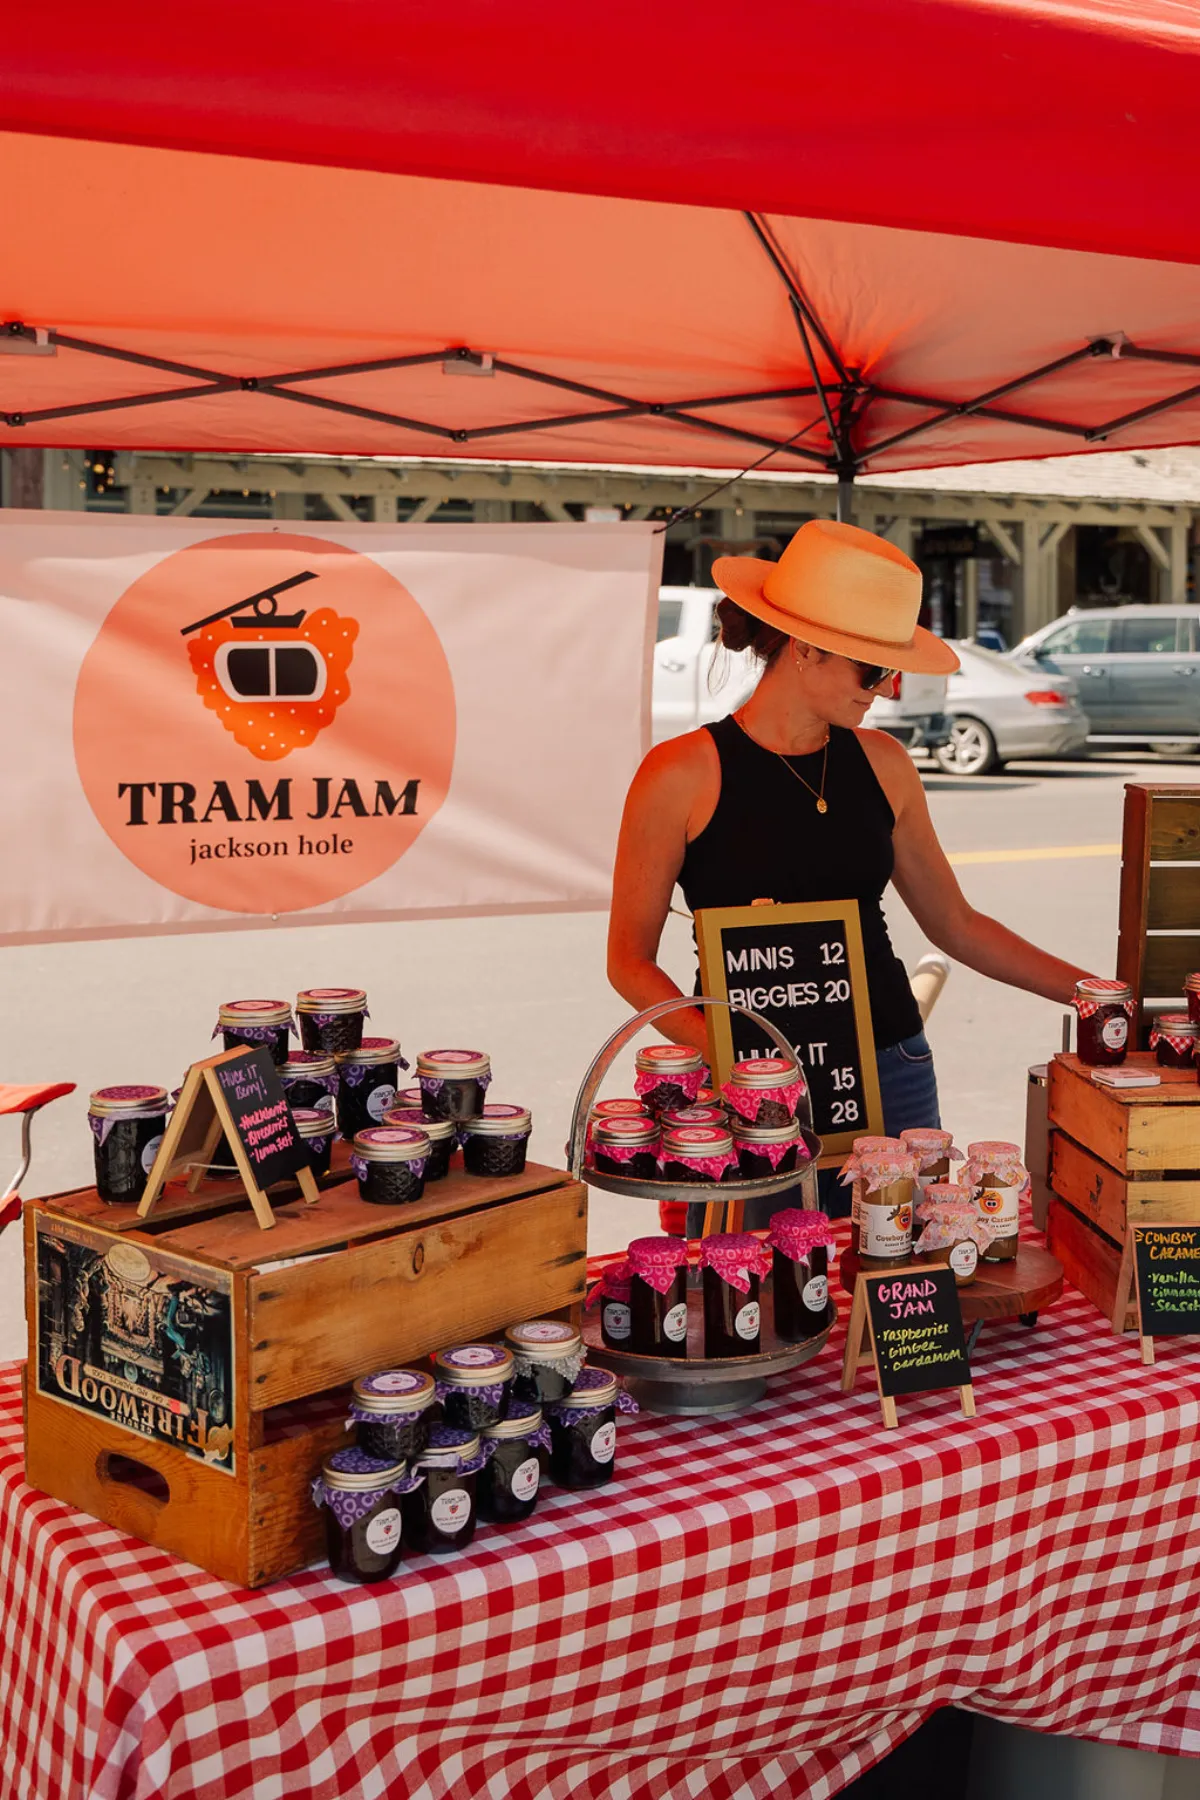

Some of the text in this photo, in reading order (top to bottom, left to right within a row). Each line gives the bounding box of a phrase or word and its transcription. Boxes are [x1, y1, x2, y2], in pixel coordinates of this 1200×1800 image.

[118, 777, 422, 826] TRAM JAM
[190, 834, 353, 865] jackson hole
[726, 942, 846, 973] MINIS 12
[728, 979, 851, 1012] BIGGIES 20
[808, 1042, 828, 1067] IT
[830, 1067, 856, 1091] 15
[830, 1099, 859, 1124] 28
[1145, 1231, 1197, 1245] COWBOY
[1149, 1245, 1200, 1260] CARAME
[878, 1279, 937, 1303] GRAND
[889, 1300, 935, 1319] JAM
[883, 1322, 949, 1345] raspberries
[55, 1354, 209, 1449] FIREWOOD
